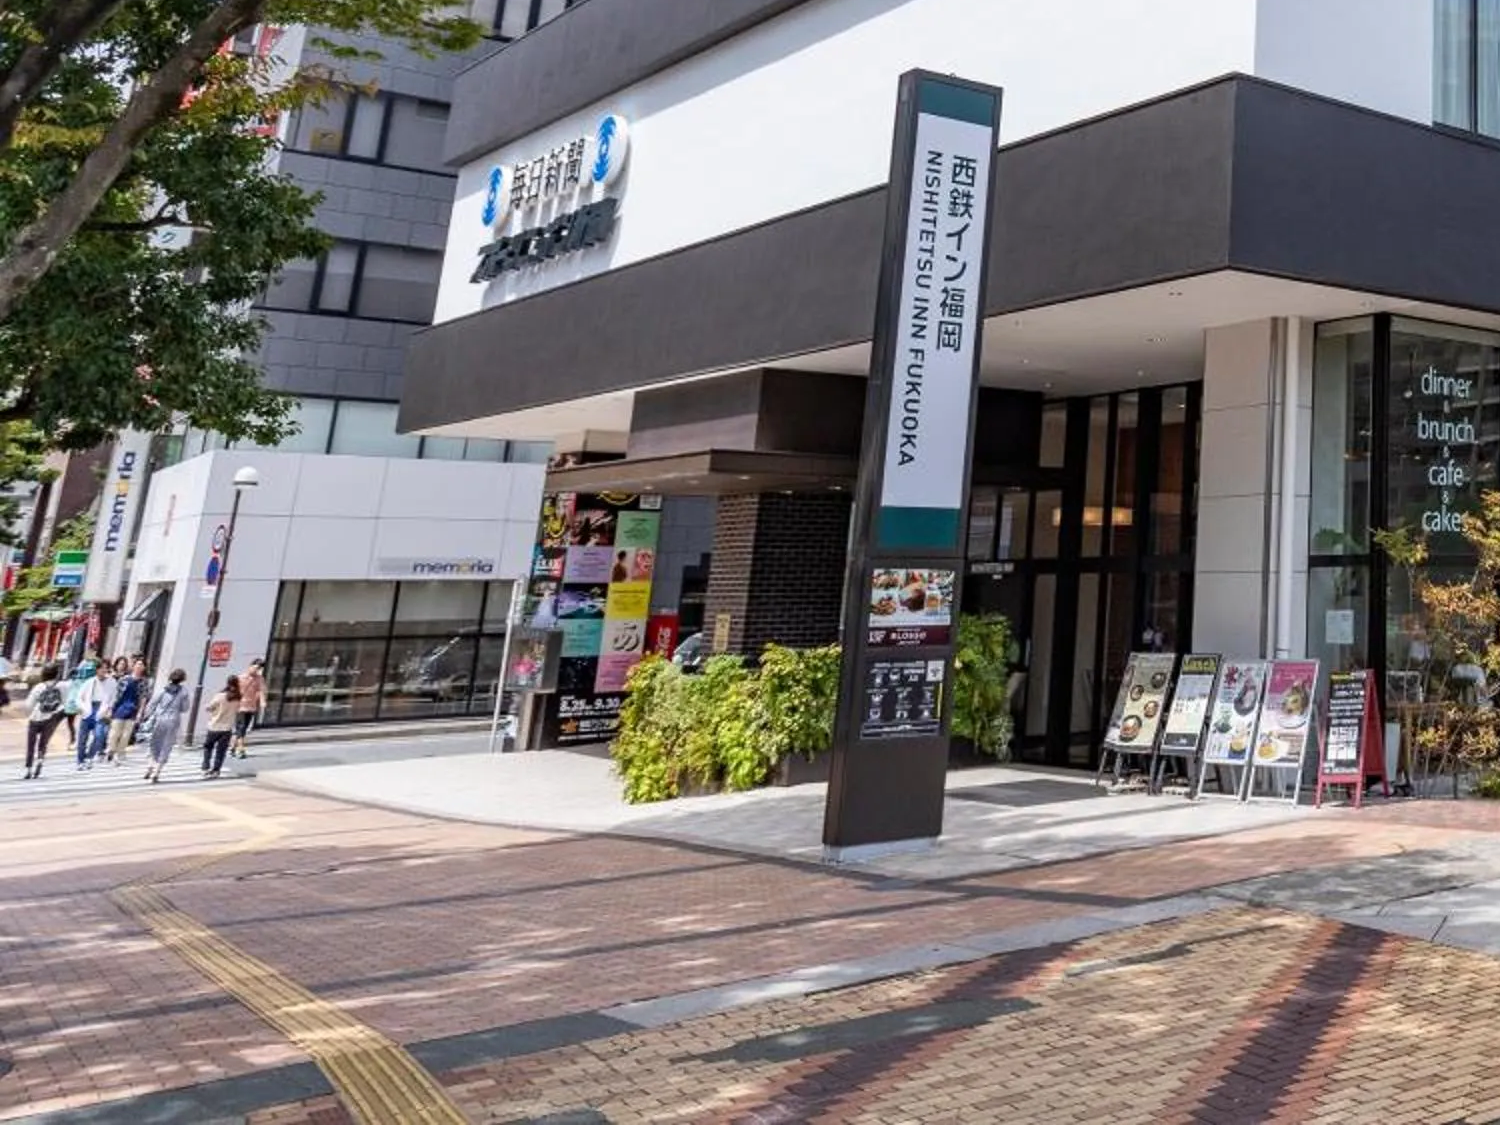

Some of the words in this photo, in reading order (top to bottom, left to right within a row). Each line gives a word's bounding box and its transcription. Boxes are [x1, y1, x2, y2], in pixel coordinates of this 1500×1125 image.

[510, 139, 585, 210] 毎日新聞
[915, 150, 943, 290] NISHITETSU
[937, 155, 977, 352] 西鉄イン福岡
[910, 297, 929, 340] INN
[1421, 365, 1472, 398] dinner
[898, 348, 924, 466] FUKUOKA
[1417, 412, 1475, 442] brunch
[1428, 460, 1464, 486] cafe
[104, 452, 136, 552] memoria
[1422, 505, 1464, 532] cake
[414, 559, 493, 573] memoria
